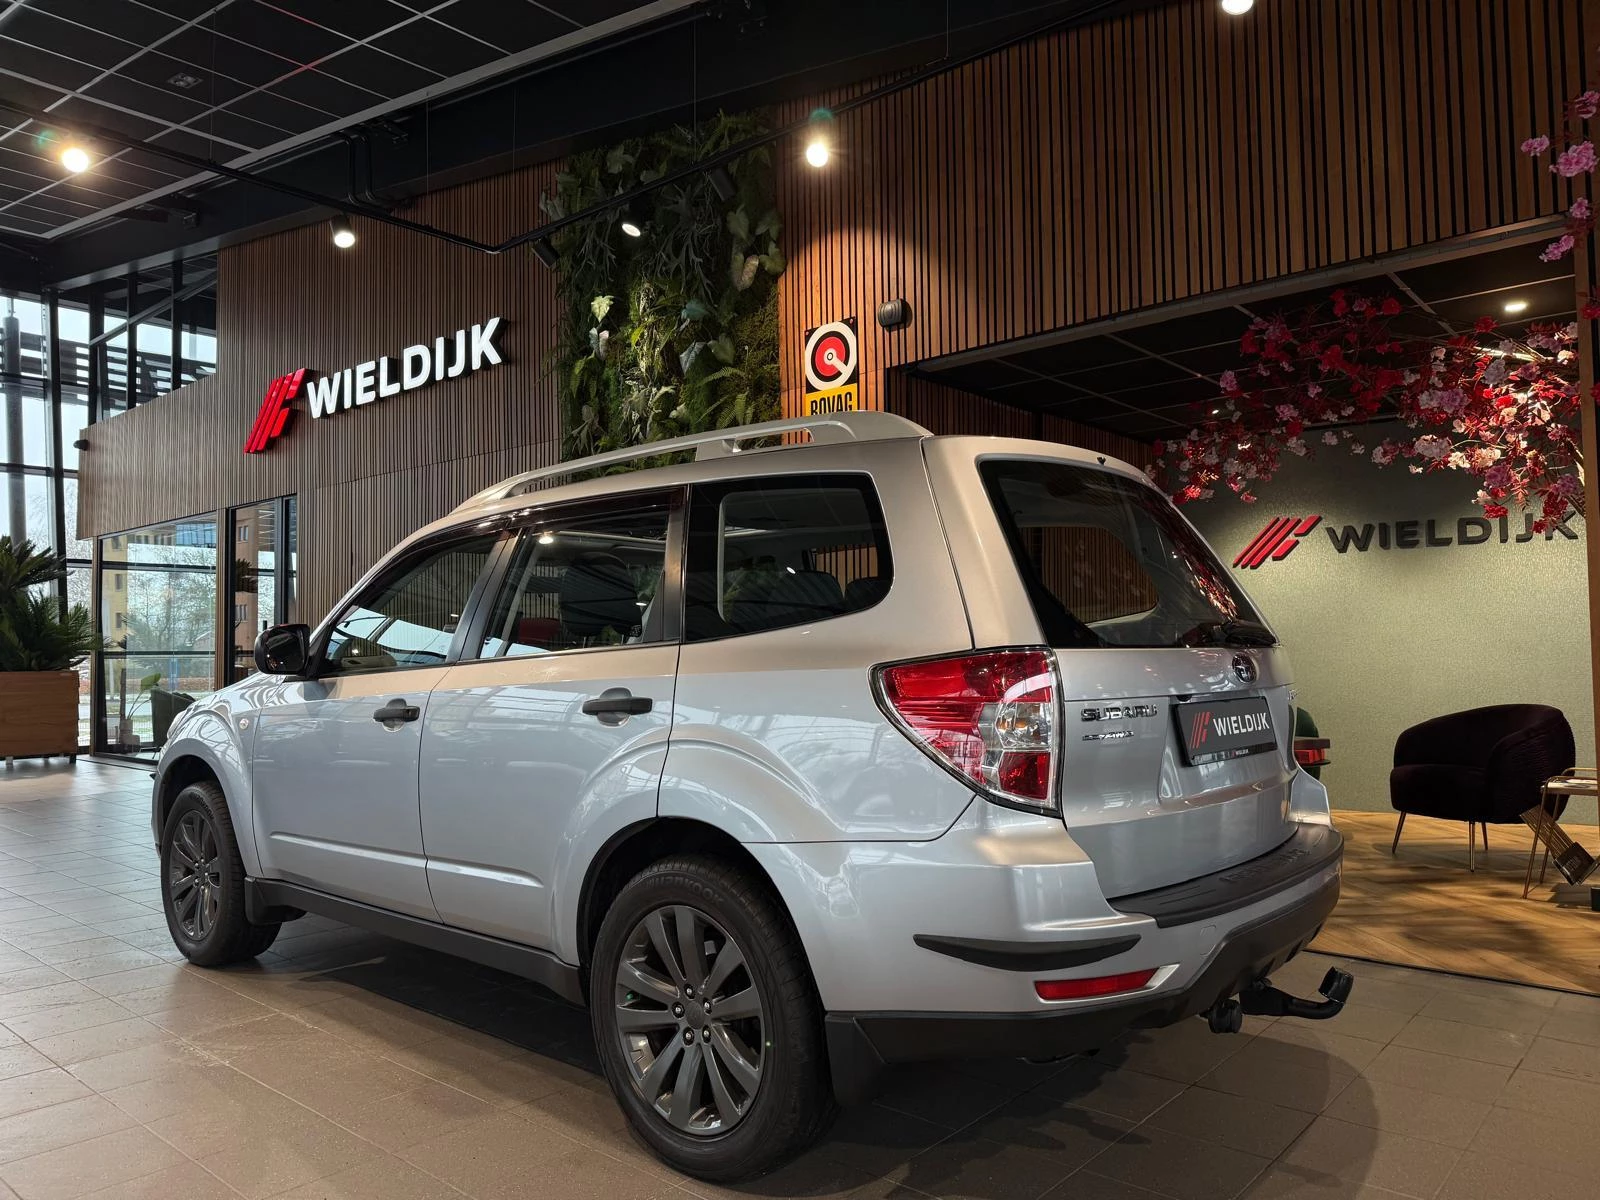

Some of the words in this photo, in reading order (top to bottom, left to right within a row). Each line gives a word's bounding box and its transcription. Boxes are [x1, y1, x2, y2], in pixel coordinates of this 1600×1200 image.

[306, 317, 502, 419] WIELDIJK
[810, 392, 852, 416] BOVAG
[1325, 510, 1579, 554] WIELDIJK
[1081, 705, 1158, 721] SUBARU
[1213, 712, 1270, 737] WIELDIJK
